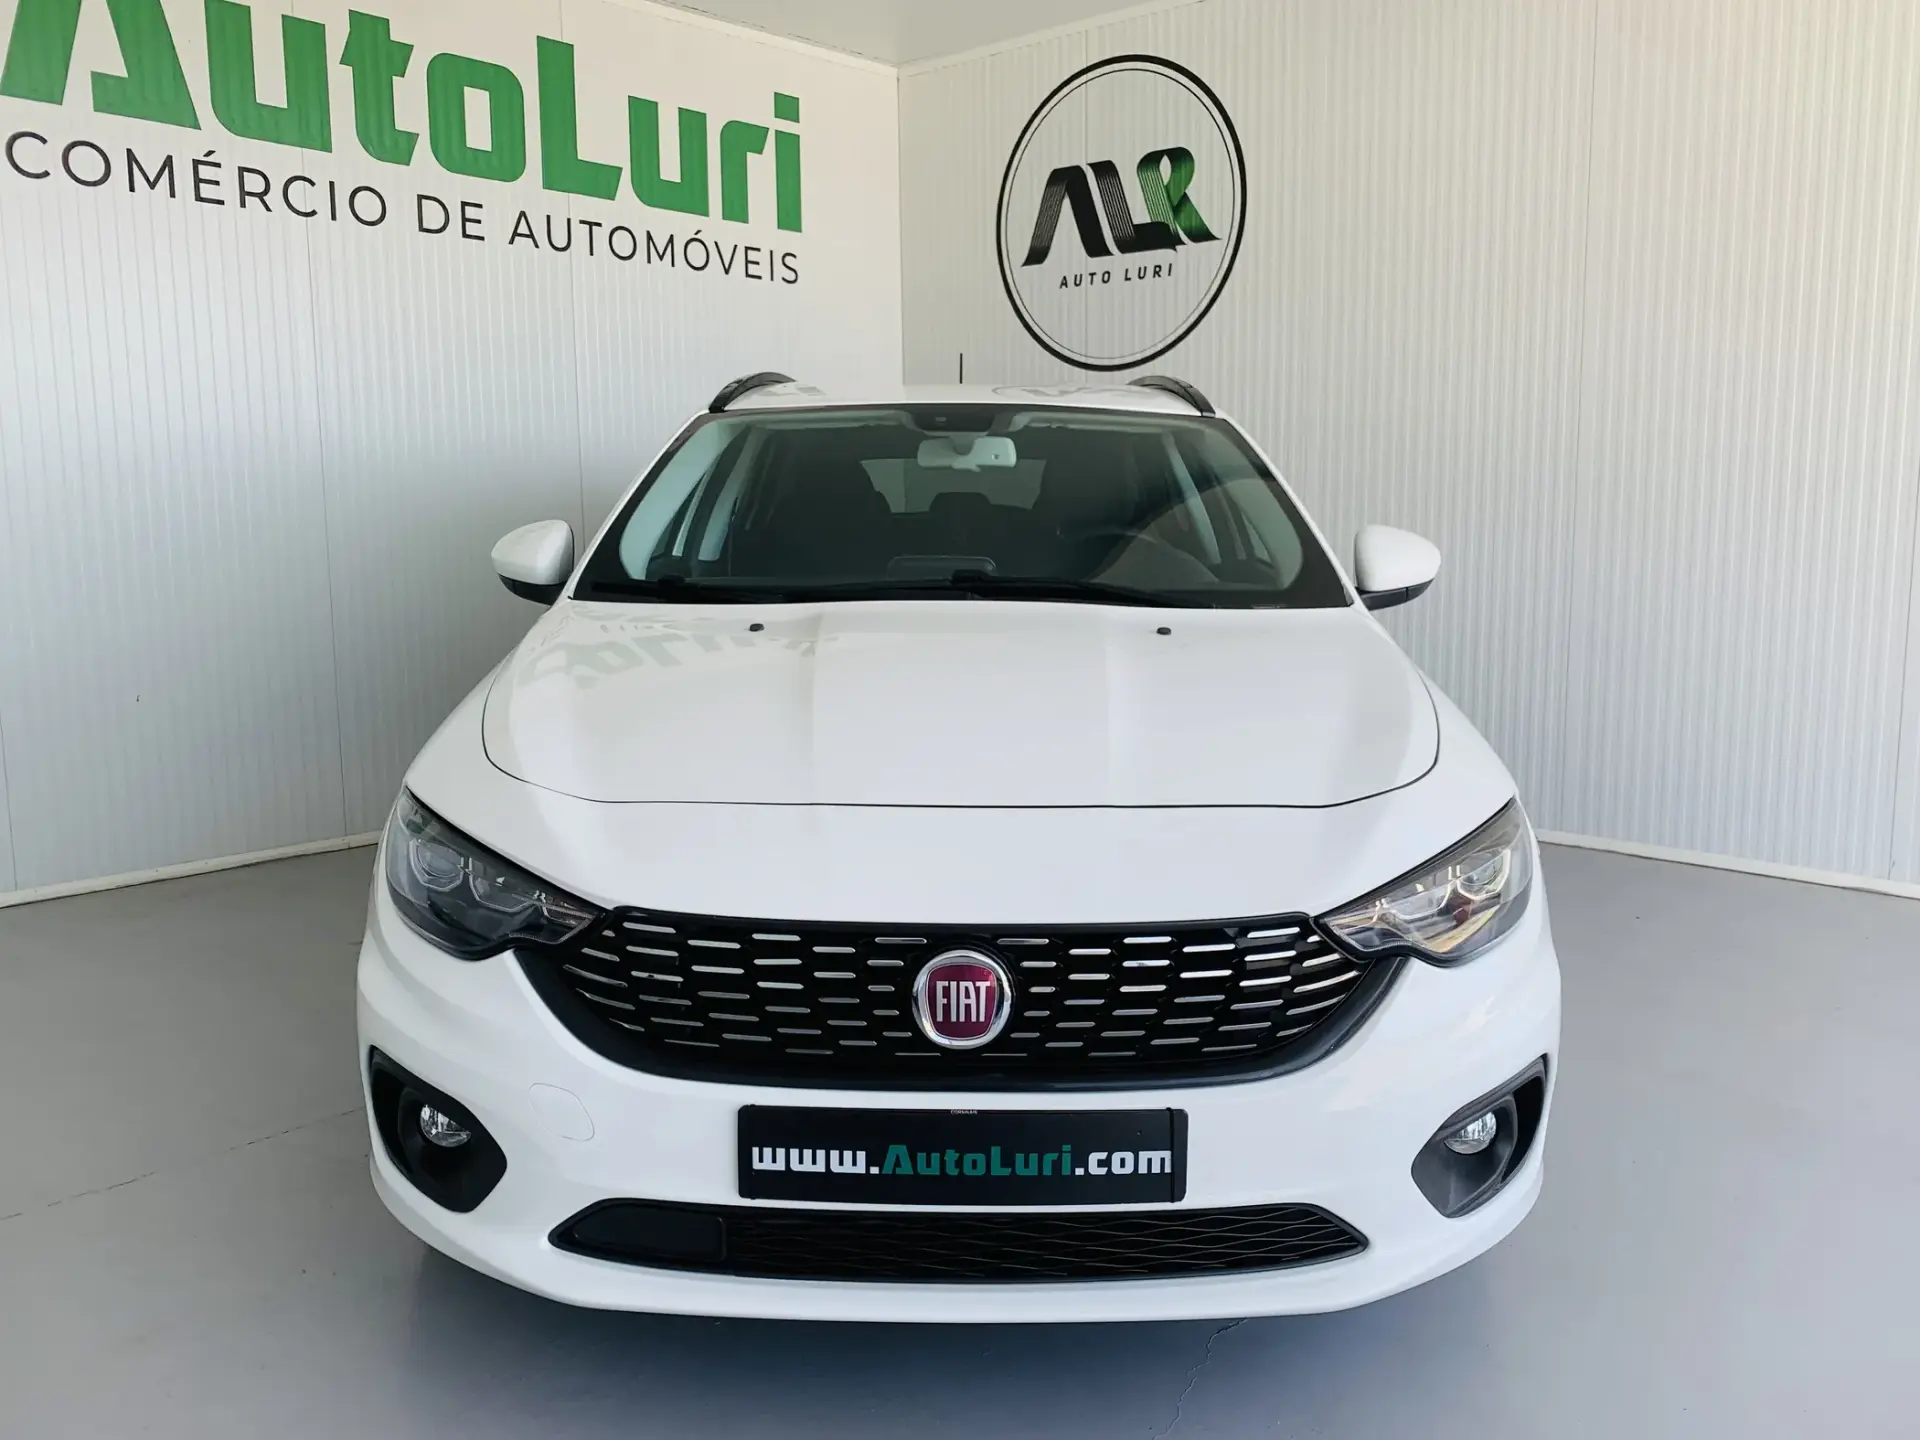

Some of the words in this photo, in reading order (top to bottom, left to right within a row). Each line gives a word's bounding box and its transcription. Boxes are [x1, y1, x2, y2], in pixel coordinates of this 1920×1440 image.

[0, 0, 803, 233] AutoLuri
[4, 130, 389, 227] COMÉRCIO
[416, 193, 486, 242] DE
[508, 209, 801, 285] AUTOMÓVEIS
[1059, 270, 1112, 289] AUTO
[1124, 262, 1173, 282] LURI
[935, 980, 991, 1023] FIAT
[751, 1144, 1173, 1176] www.AutoLuri.com
